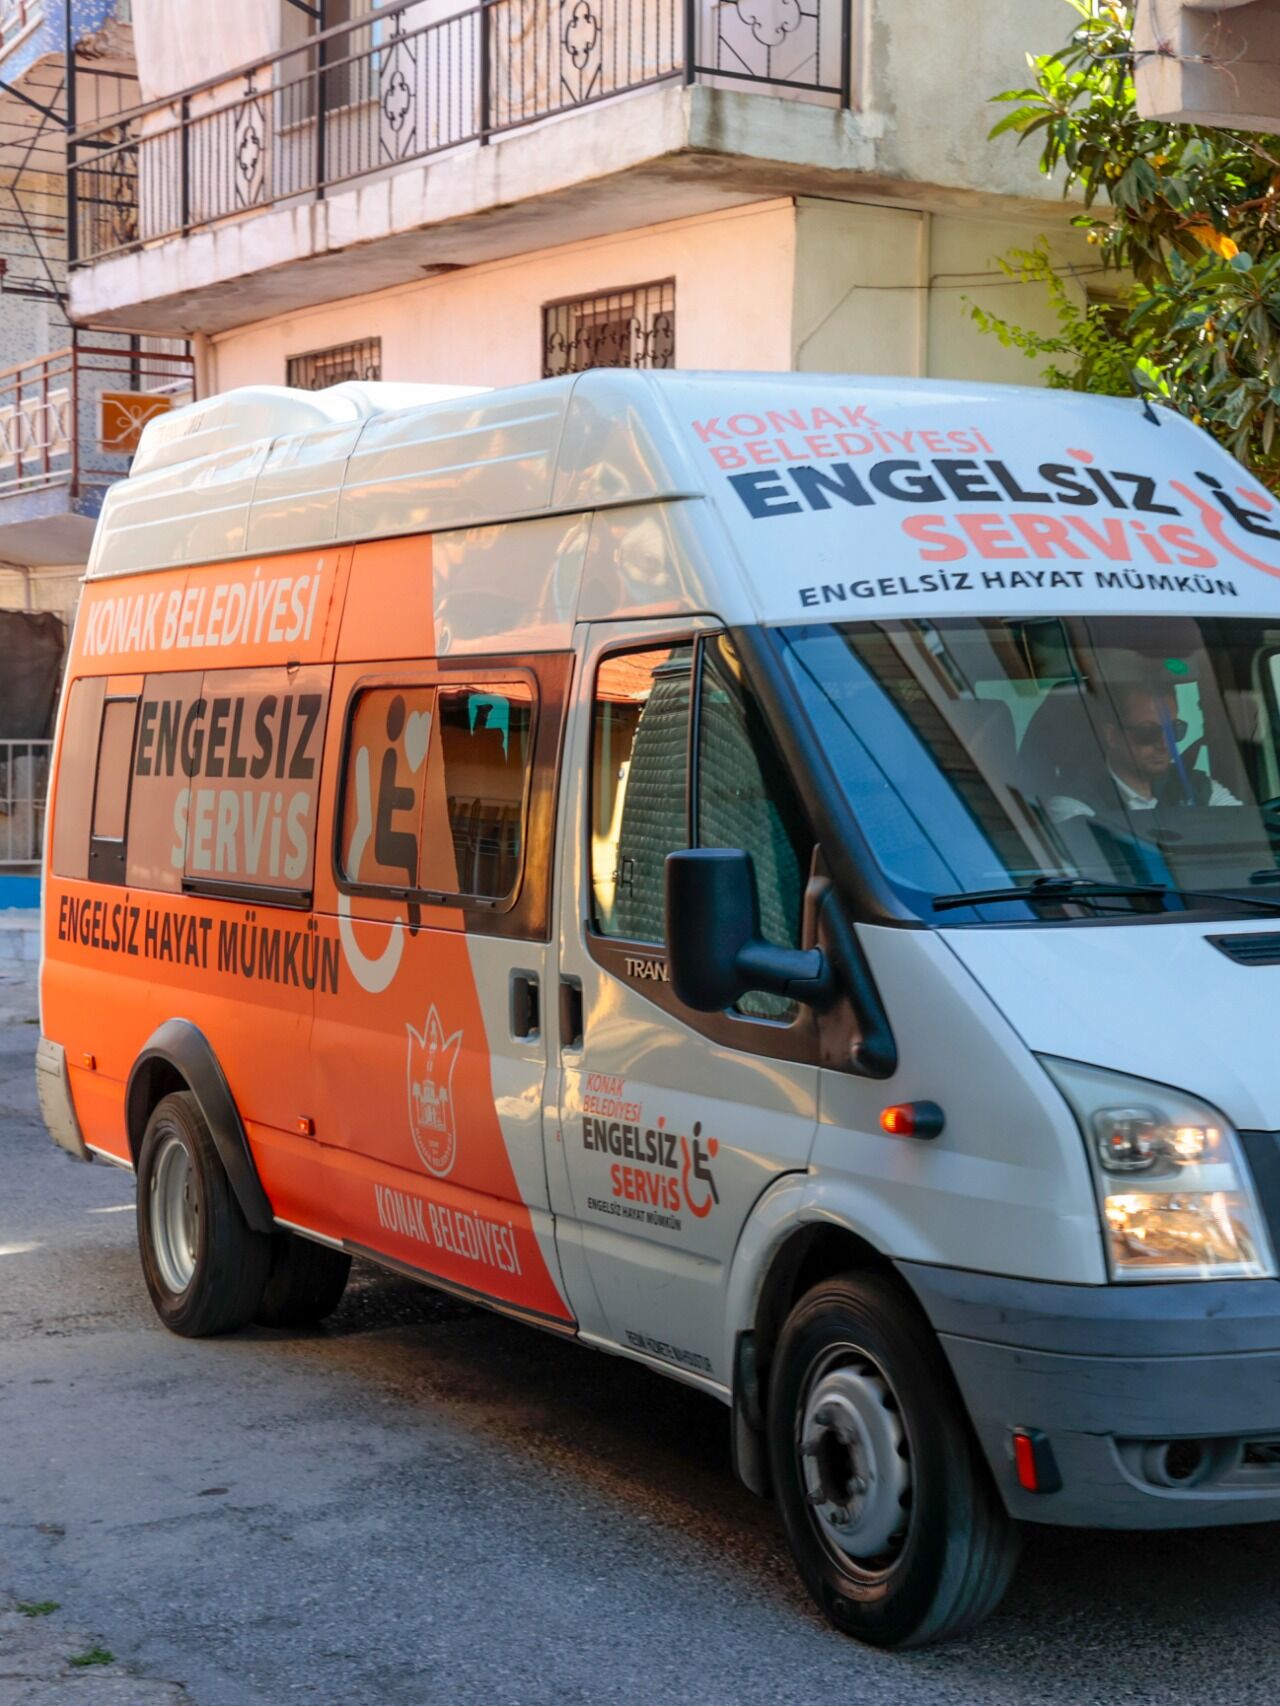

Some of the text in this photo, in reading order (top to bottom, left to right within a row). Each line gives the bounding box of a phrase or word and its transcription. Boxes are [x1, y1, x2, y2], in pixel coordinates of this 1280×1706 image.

[691, 405, 881, 444] KONAK
[708, 426, 995, 470] BELEDİYESİ
[82, 558, 324, 657] KONAK BELEDİYESİ
[797, 568, 1239, 608] ENGELSİZ HAYAT MÜMKÜN
[58, 893, 341, 995] ENGELSİZ HAYAT MÜMKÜN
[624, 957, 671, 982] TRAN
[586, 1073, 626, 1097] KONAK
[374, 1183, 522, 1276] KONAK BELEDİYESİ
